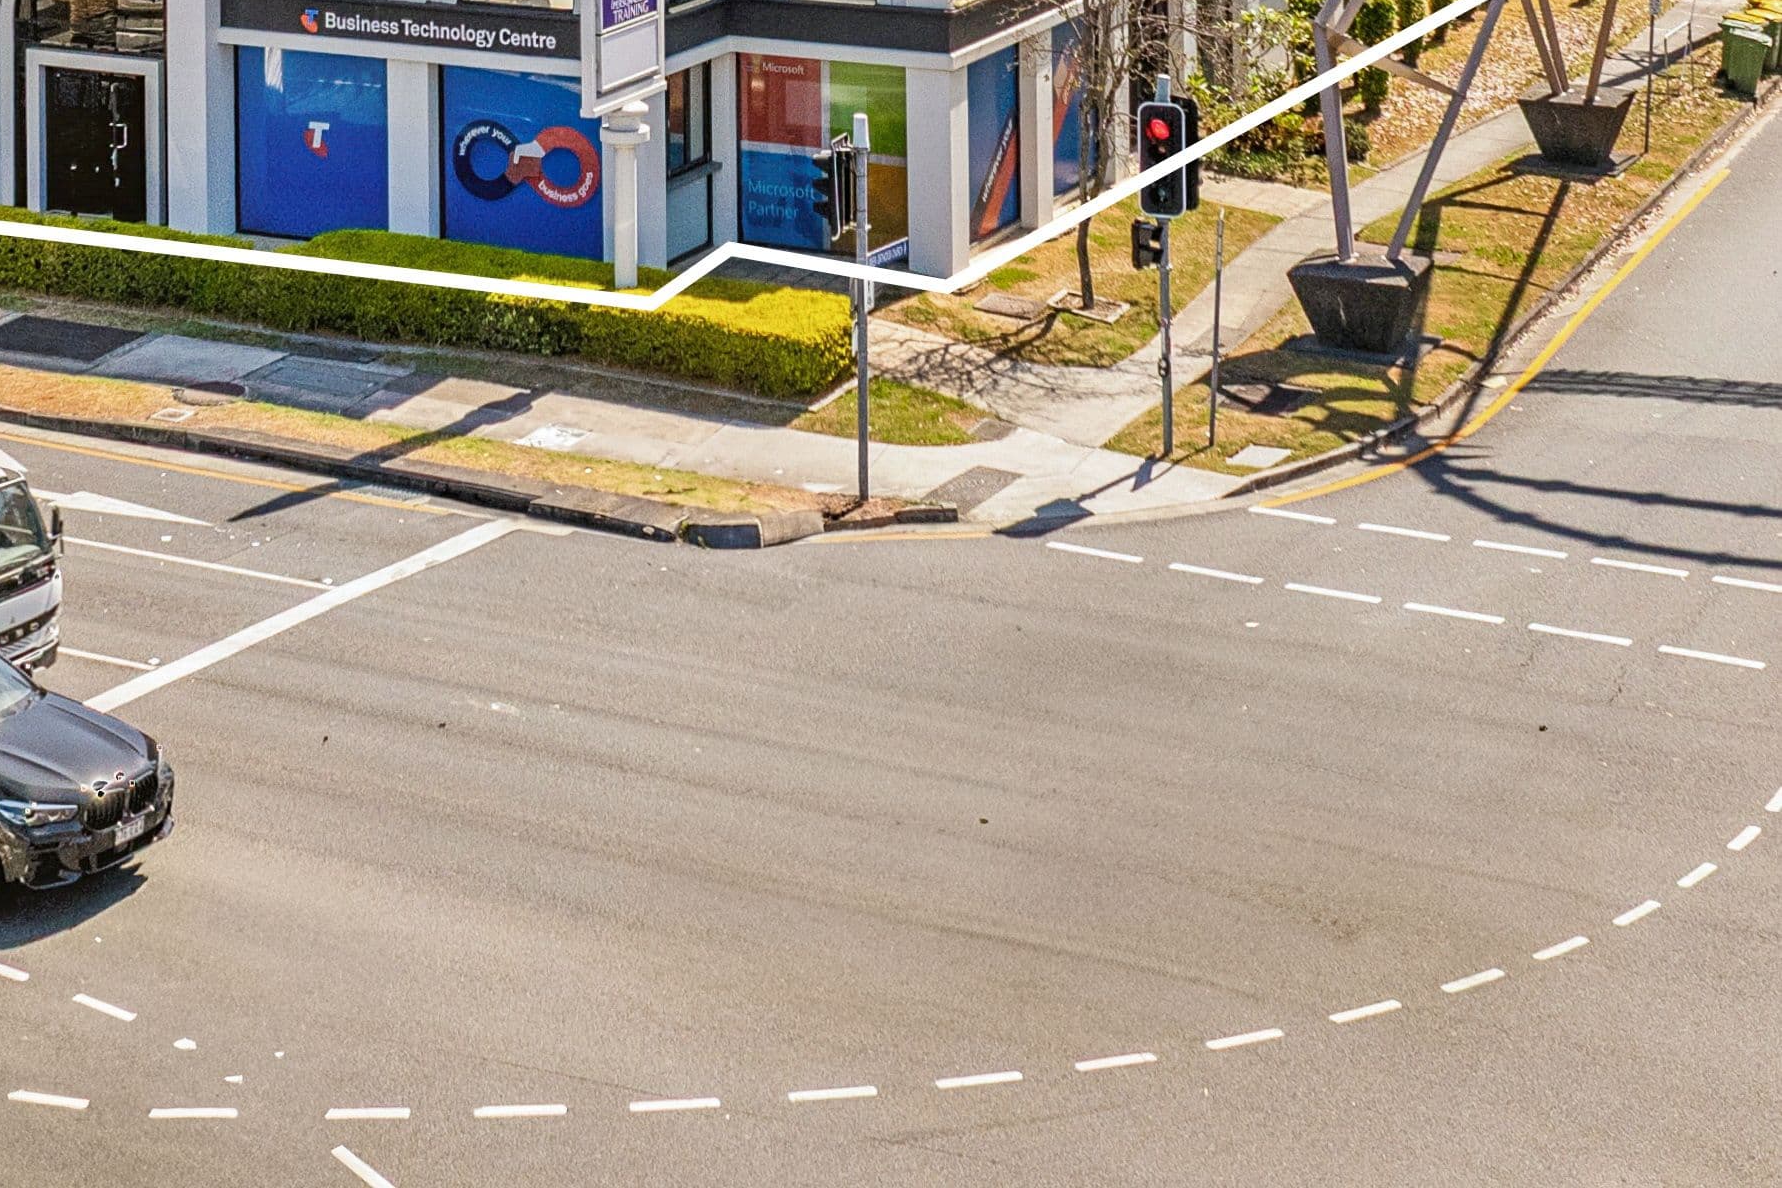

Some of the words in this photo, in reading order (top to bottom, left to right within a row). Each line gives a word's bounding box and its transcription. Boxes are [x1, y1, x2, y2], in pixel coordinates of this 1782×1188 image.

[612, 0, 649, 24] TRAINING
[325, 12, 399, 35] Business
[400, 18, 496, 48] Technology
[498, 28, 557, 49] Centre
[762, 61, 805, 75] Microsoft
[459, 125, 491, 156] wherever
[491, 127, 512, 146] your
[537, 179, 579, 203] business
[578, 171, 594, 198] goes
[748, 179, 816, 201] Microsoft
[748, 200, 799, 220] Partner
